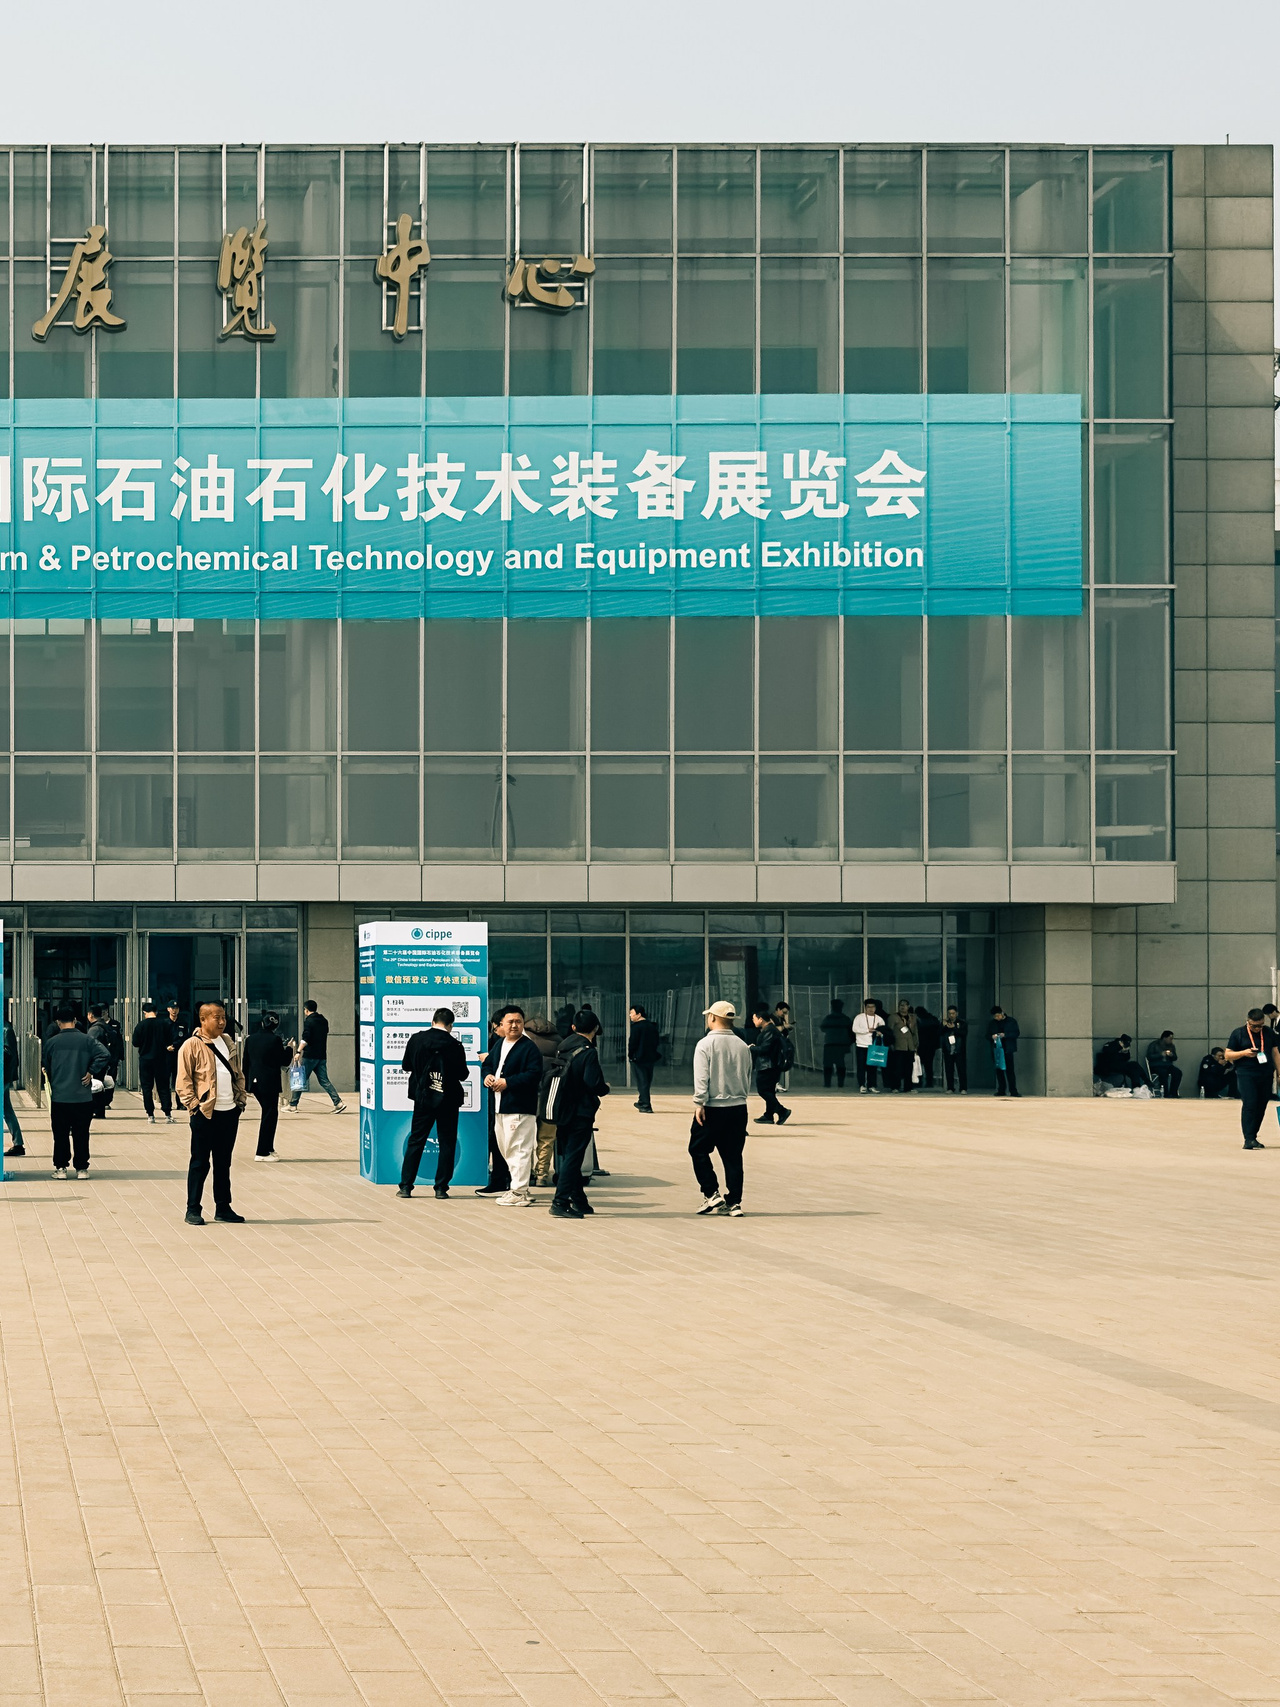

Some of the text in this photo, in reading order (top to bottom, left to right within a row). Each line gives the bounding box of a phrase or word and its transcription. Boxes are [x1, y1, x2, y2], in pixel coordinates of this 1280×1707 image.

[40, 545, 61, 570] &
[72, 546, 297, 570] Petrochemical
[309, 545, 493, 576] Technology
[505, 544, 562, 569] and
[576, 543, 750, 574] Equipment
[762, 542, 923, 567] Exhibition
[425, 929, 453, 941] cippe
[385, 975, 428, 984] 微信预登记
